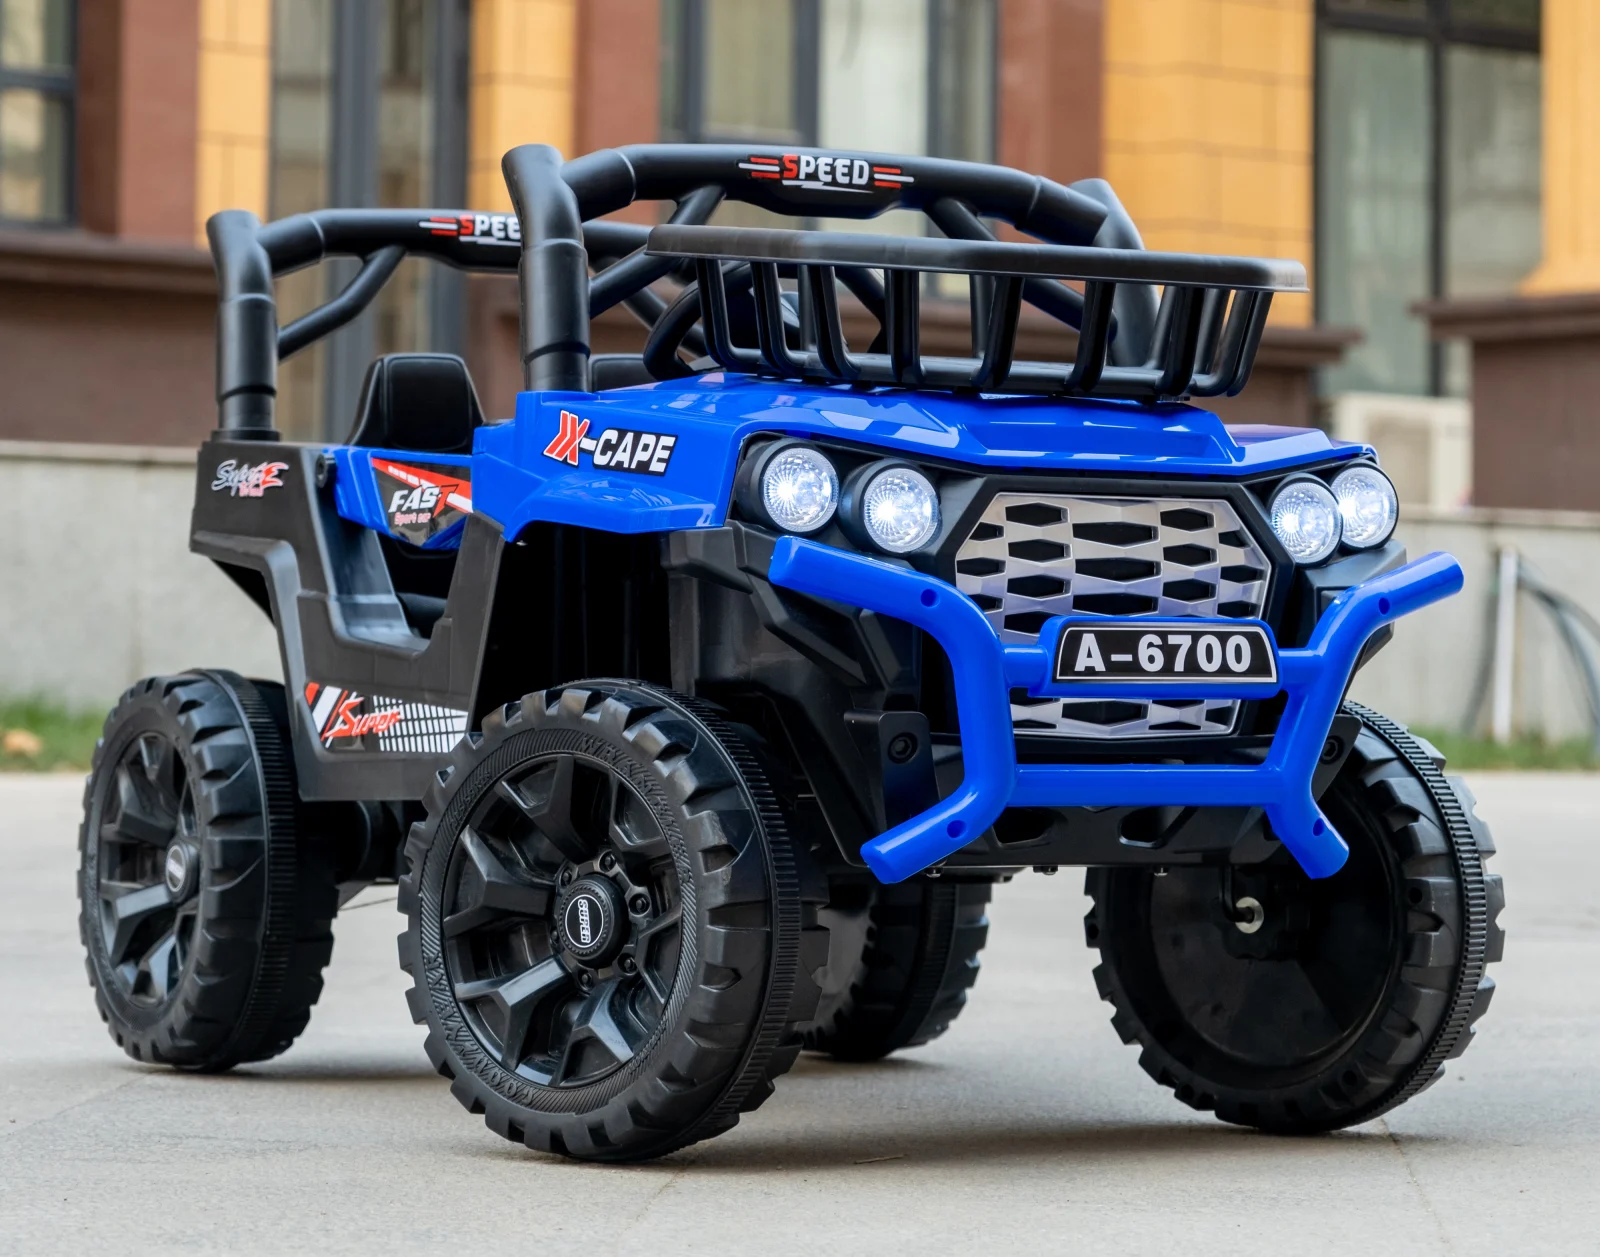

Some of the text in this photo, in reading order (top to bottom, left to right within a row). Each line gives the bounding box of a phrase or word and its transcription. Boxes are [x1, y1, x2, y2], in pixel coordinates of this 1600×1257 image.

[782, 153, 870, 186] SPEED
[459, 214, 521, 240] SPEE
[543, 409, 677, 473] X-CAPE
[387, 483, 459, 518] FAST
[1073, 633, 1252, 673] A-6700
[577, 898, 592, 944] SUPER
